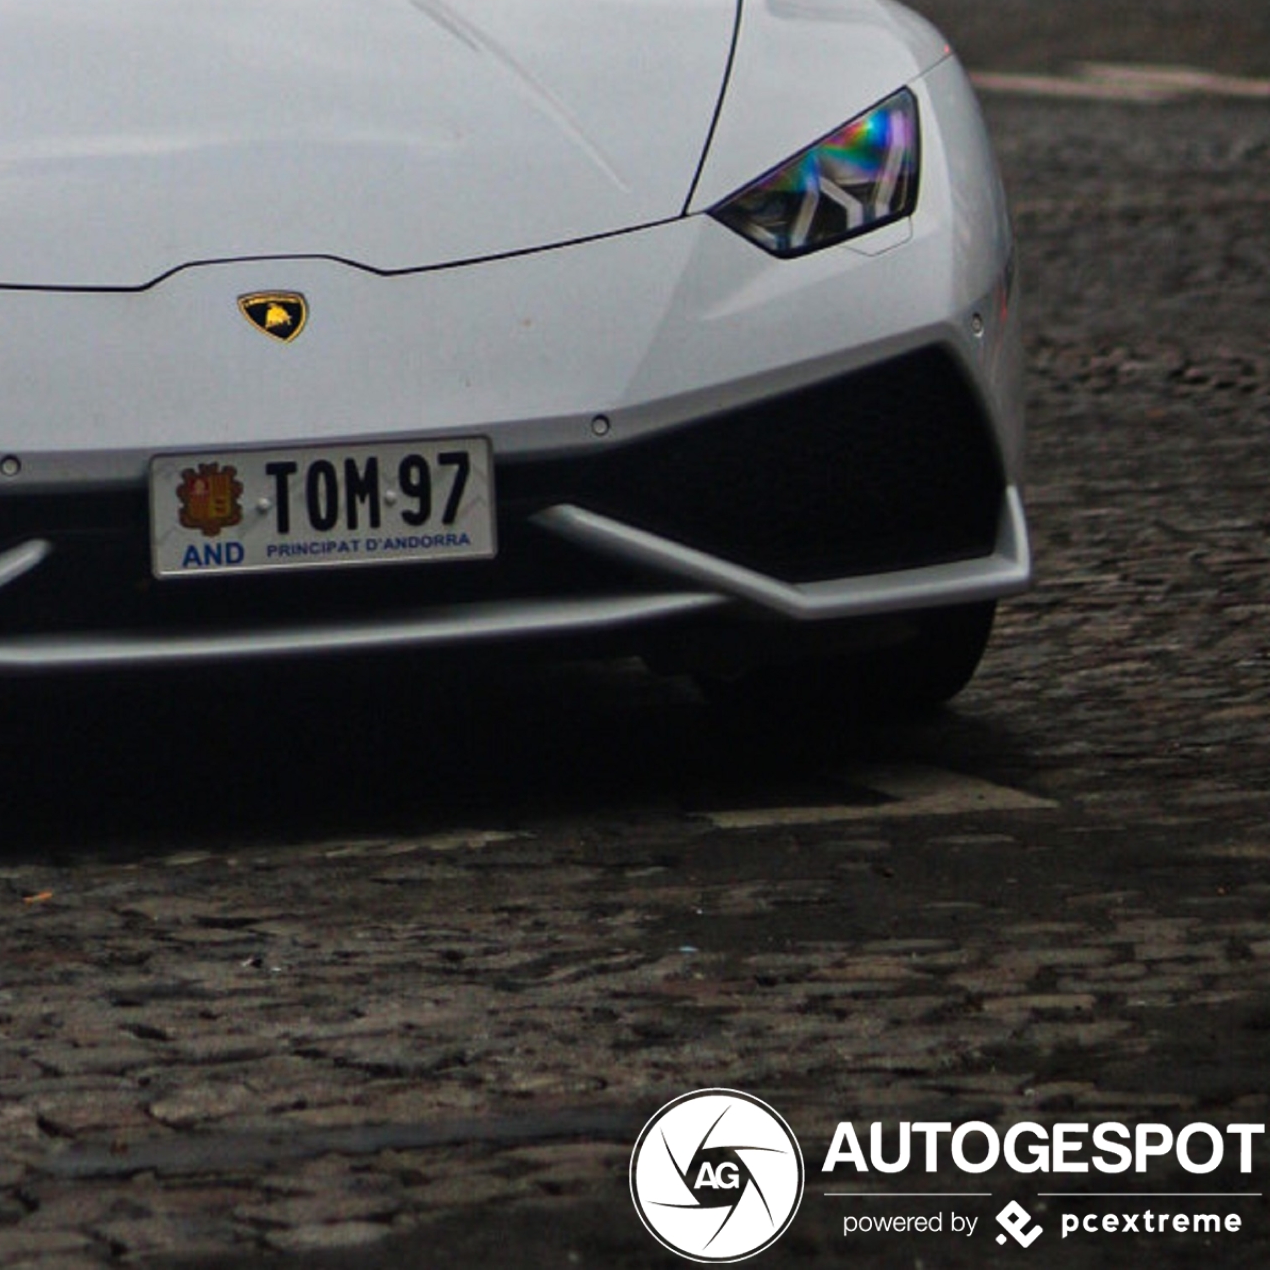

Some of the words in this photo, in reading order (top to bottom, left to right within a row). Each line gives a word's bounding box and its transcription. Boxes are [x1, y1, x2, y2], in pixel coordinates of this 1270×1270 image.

[264, 455, 382, 536] TOM
[396, 450, 472, 528] 97
[182, 541, 245, 567] AND
[267, 539, 359, 558] PRINCIPAT
[365, 532, 471, 553] D'ANDORRA
